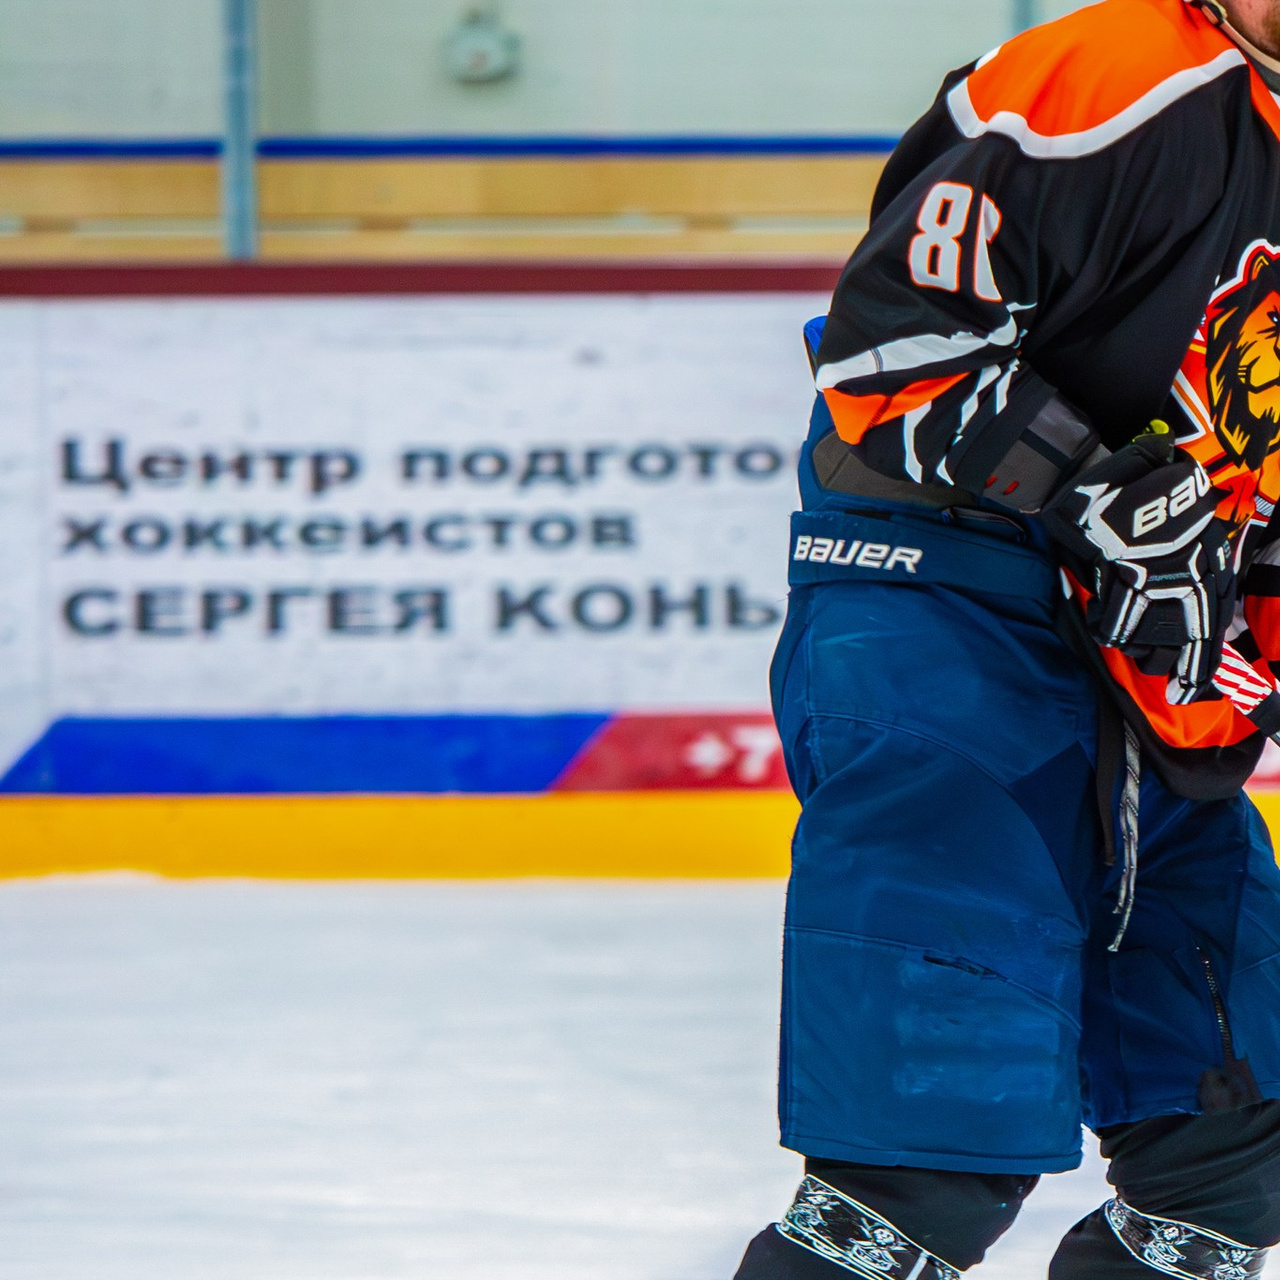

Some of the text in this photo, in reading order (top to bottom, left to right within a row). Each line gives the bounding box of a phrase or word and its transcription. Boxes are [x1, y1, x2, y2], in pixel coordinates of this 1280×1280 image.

[61, 438, 800, 496] Центр подгото
[64, 515, 634, 553] хоккеистов
[793, 535, 924, 574] BAUER
[61, 584, 781, 638] СЕРГЕЯ КОНЬ
